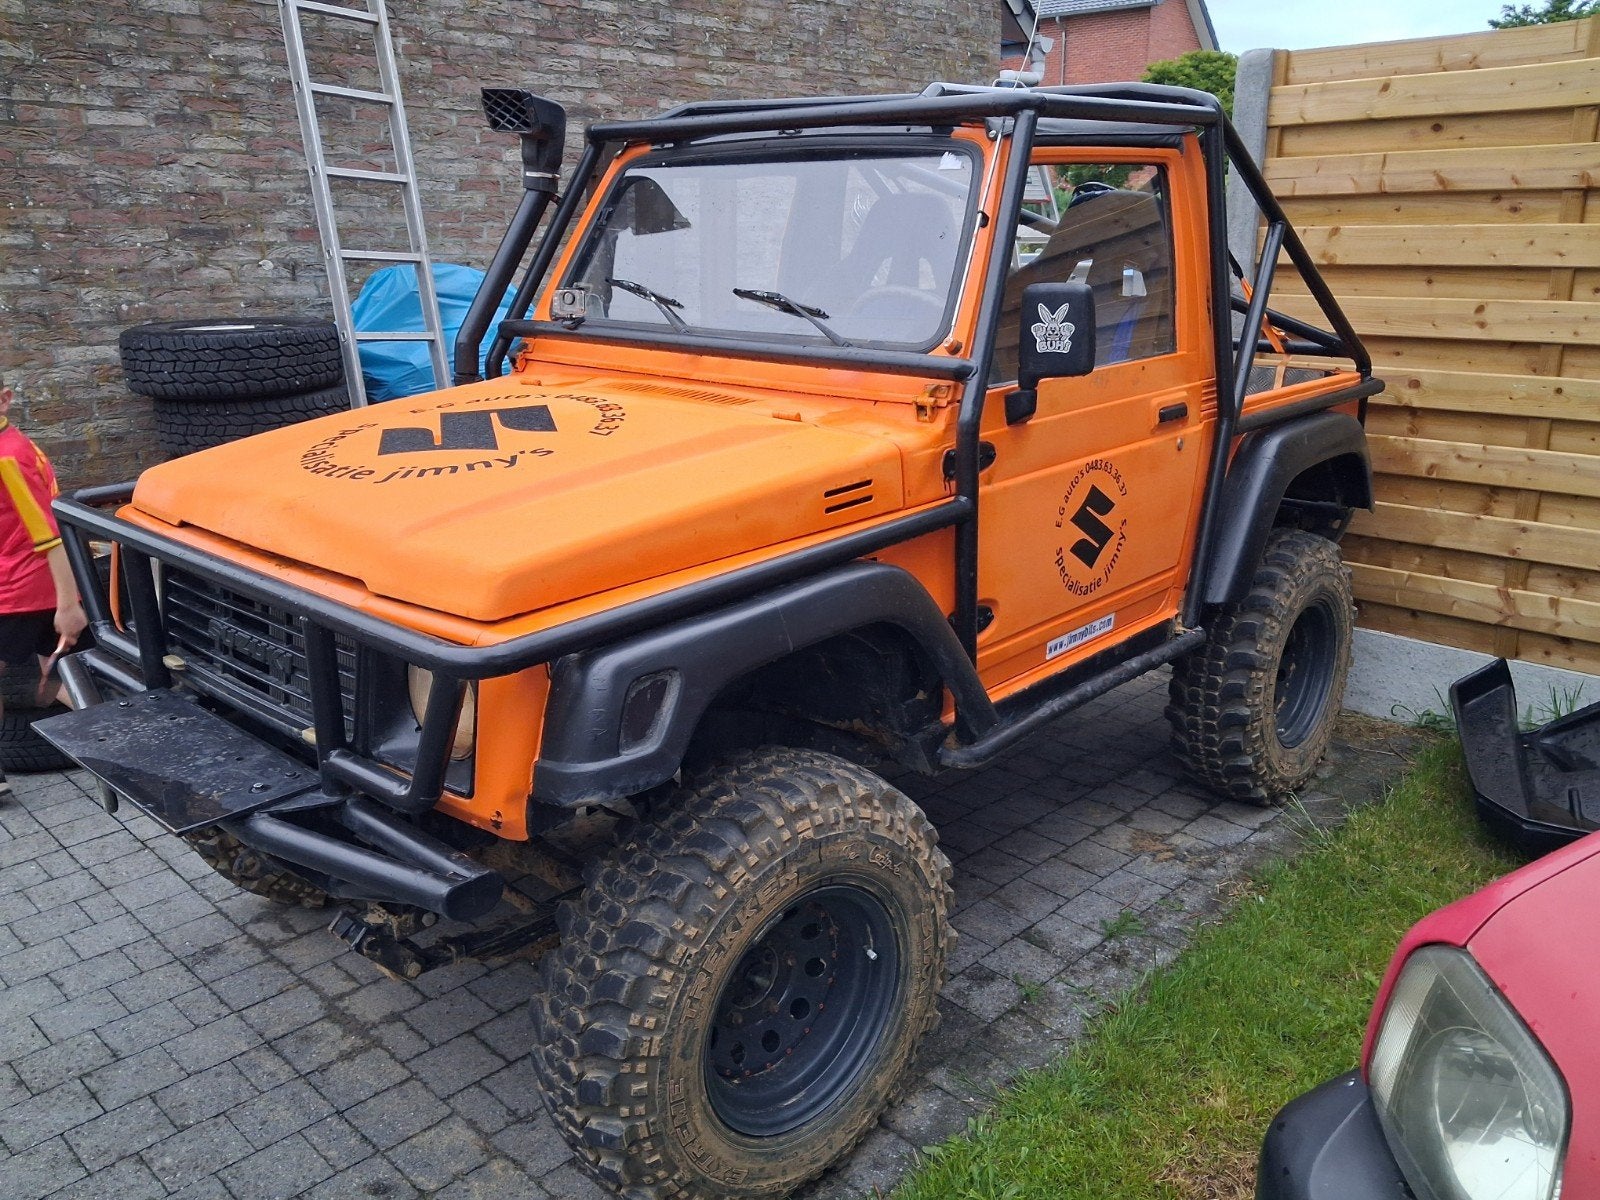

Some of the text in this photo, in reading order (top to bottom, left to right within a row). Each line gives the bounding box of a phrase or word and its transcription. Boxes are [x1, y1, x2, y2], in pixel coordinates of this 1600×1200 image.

[300, 423, 554, 484] specialisatie jimny's
[1055, 506, 1065, 528] E.G
[1063, 469, 1085, 503] auto's
[1055, 518, 1127, 596] specialisatie jimny's
